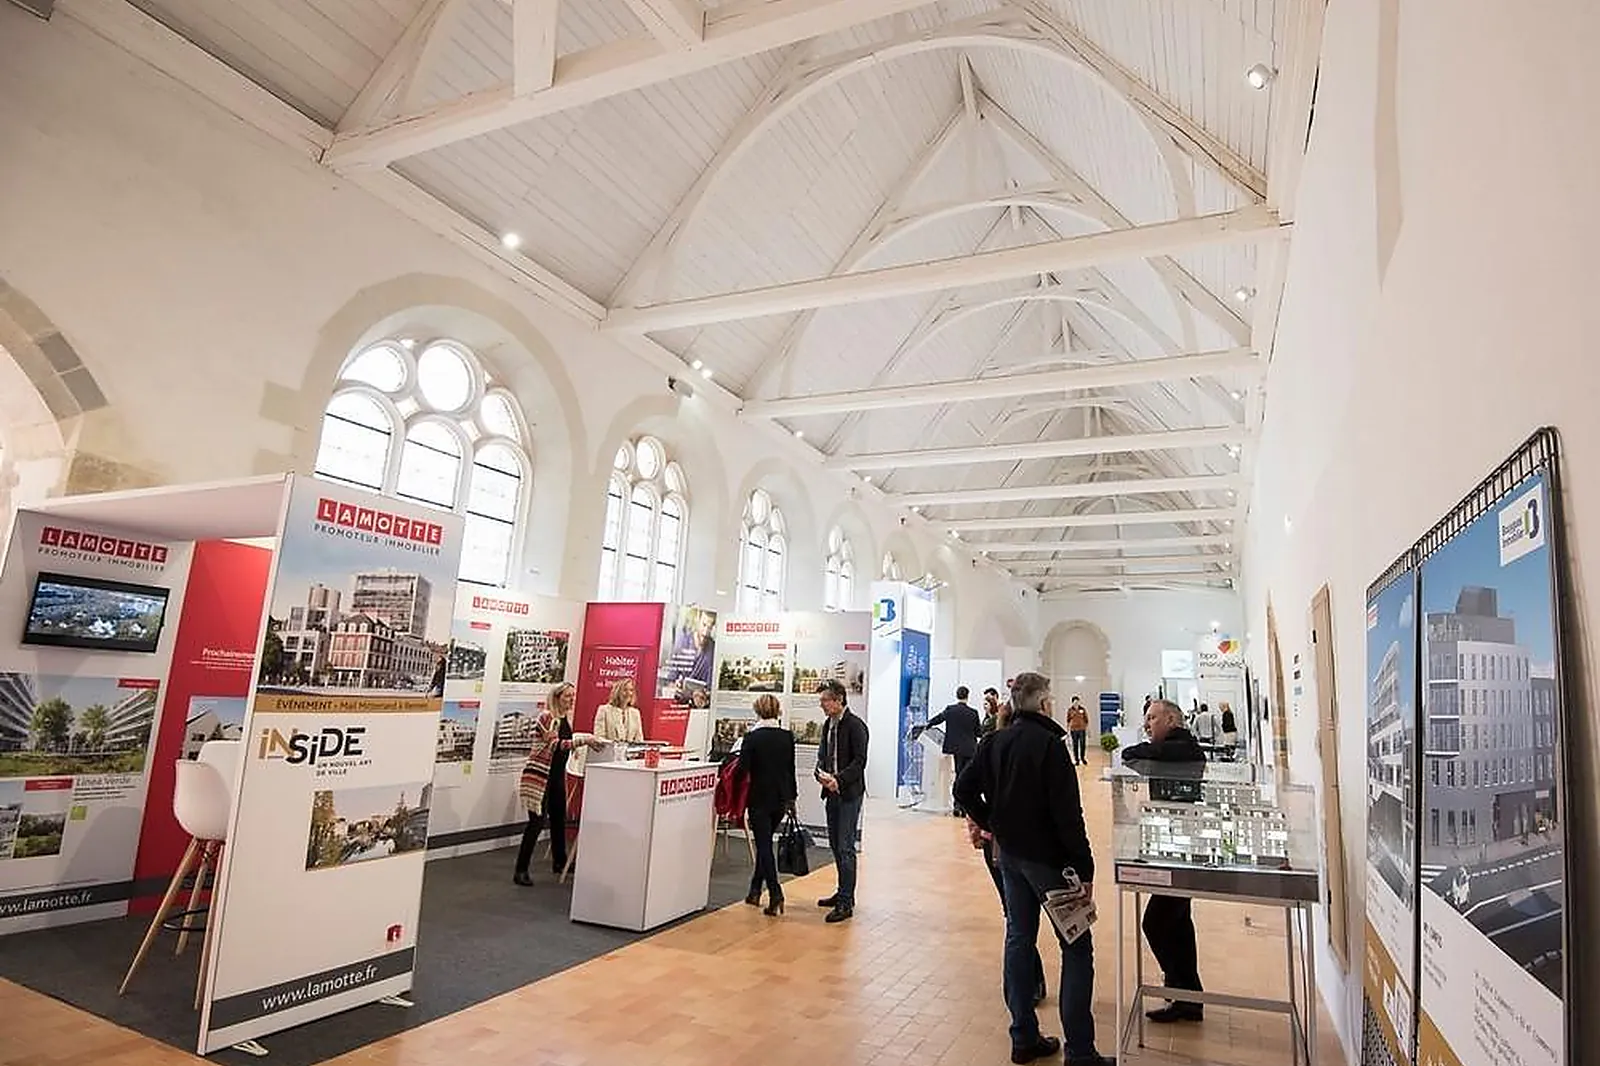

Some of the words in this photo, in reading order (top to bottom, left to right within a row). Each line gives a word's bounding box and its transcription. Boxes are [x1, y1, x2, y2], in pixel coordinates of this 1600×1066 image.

[317, 498, 442, 544] LAMOTTE
[41, 526, 168, 563] LAMOTTE
[314, 524, 379, 543] PROMOTEUR
[384, 539, 440, 556] IMMOBILIER
[38, 546, 102, 562] PROMOTEUR
[108, 558, 164, 571] IMMOBILIER
[660, 773, 716, 797] LAMOTTE
[261, 965, 378, 1010] www.lamotte.fr
